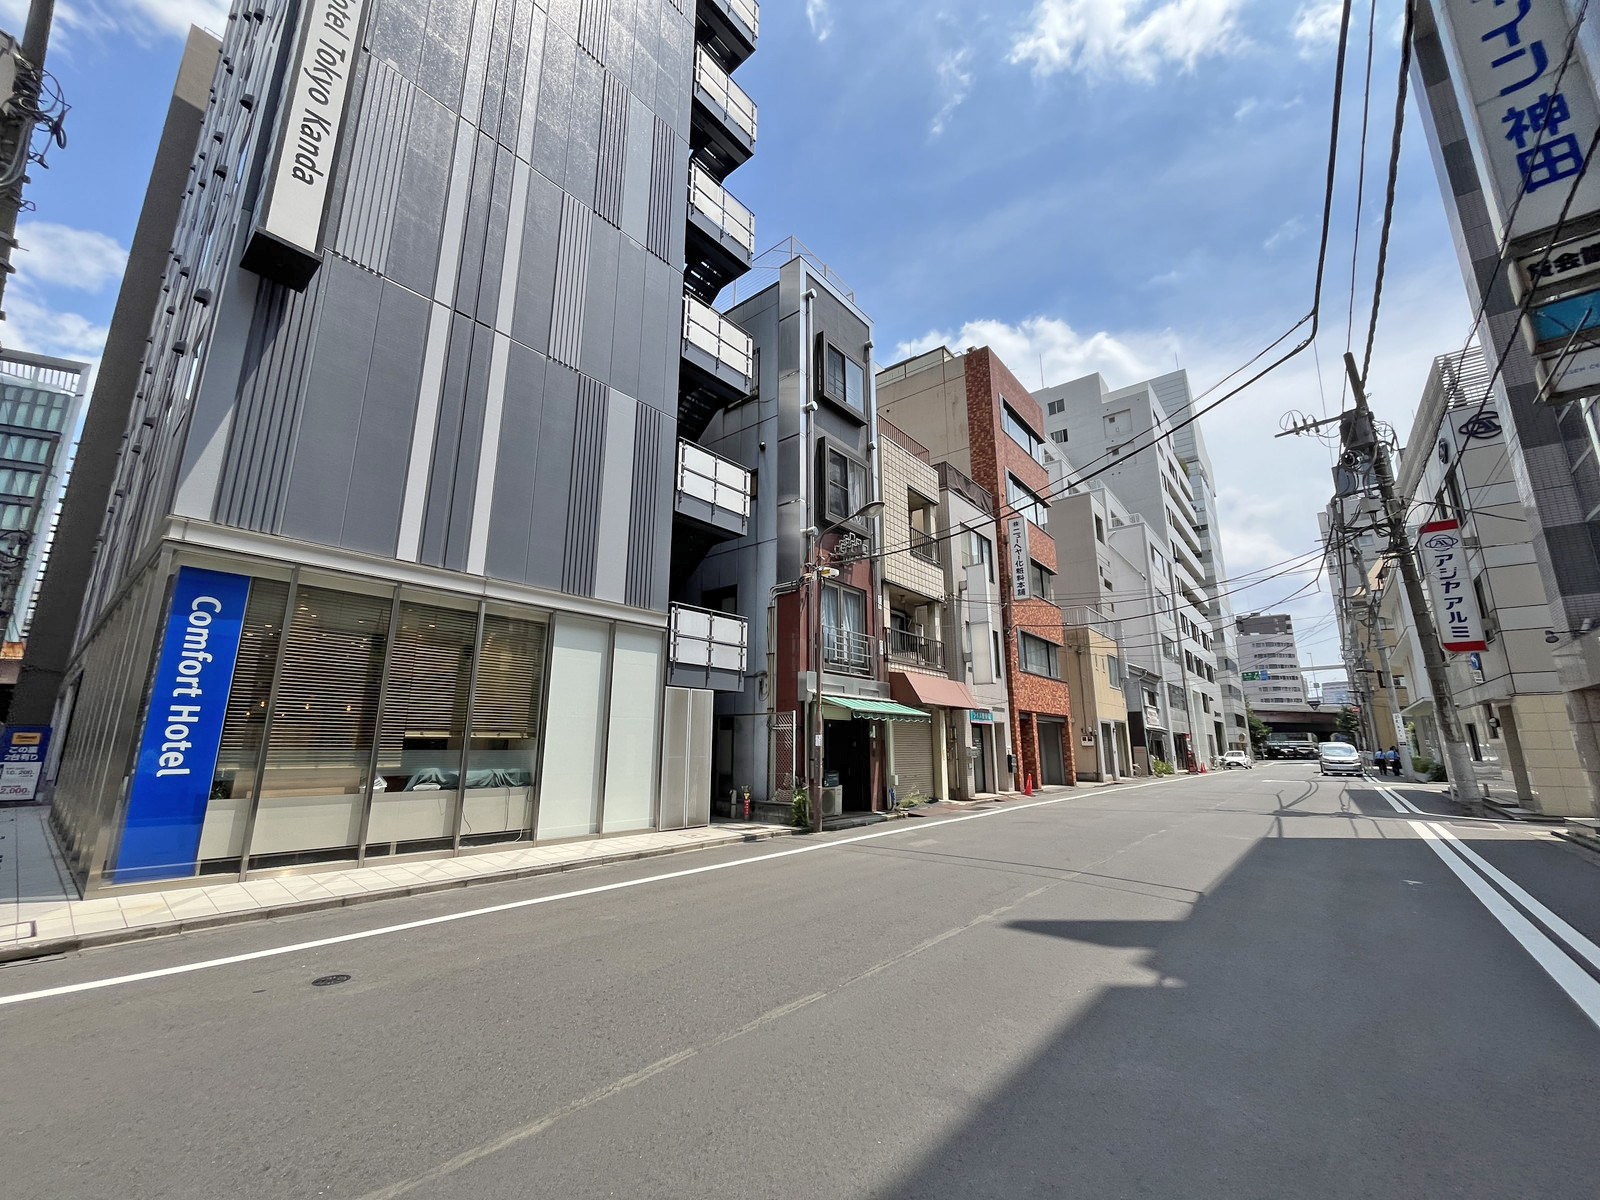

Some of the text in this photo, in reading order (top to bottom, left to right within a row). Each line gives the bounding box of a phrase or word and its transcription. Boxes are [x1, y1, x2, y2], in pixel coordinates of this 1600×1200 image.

[291, 0, 356, 186] otel Tokyo Kanda
[1470, 0, 1584, 194] イン神田
[156, 596, 222, 778] Comfort Hotel
[1434, 553, 1470, 638] アジヤアルミ
